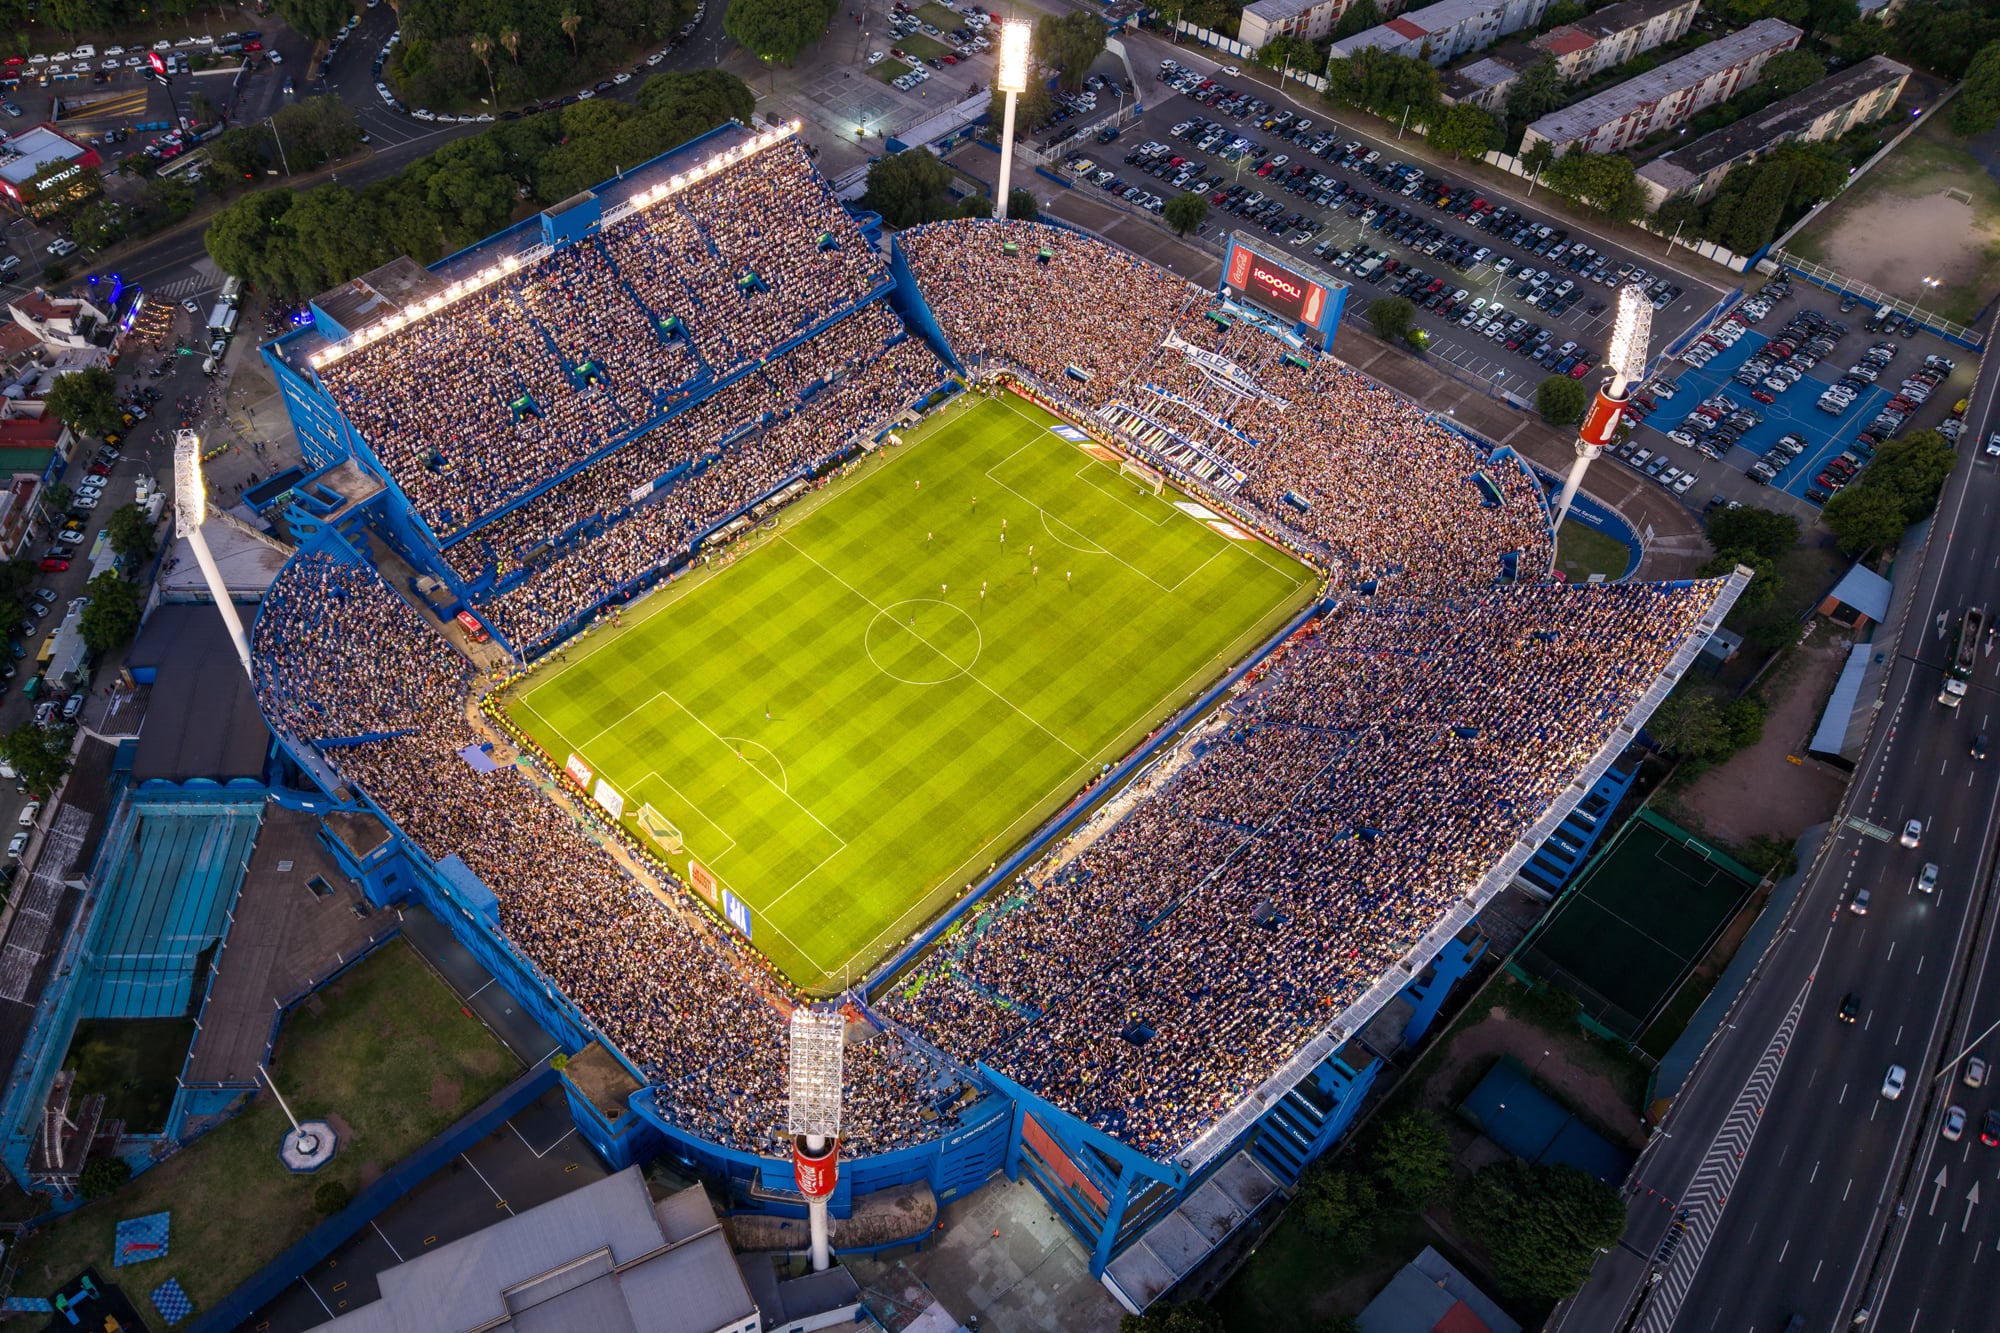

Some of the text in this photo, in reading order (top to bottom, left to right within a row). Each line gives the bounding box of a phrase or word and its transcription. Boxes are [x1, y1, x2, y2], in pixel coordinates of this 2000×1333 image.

[1254, 268, 1301, 298] ¡GOOOL!
[1196, 350, 1231, 371] VELEZ
[1198, 445, 1236, 474] MUNDO
